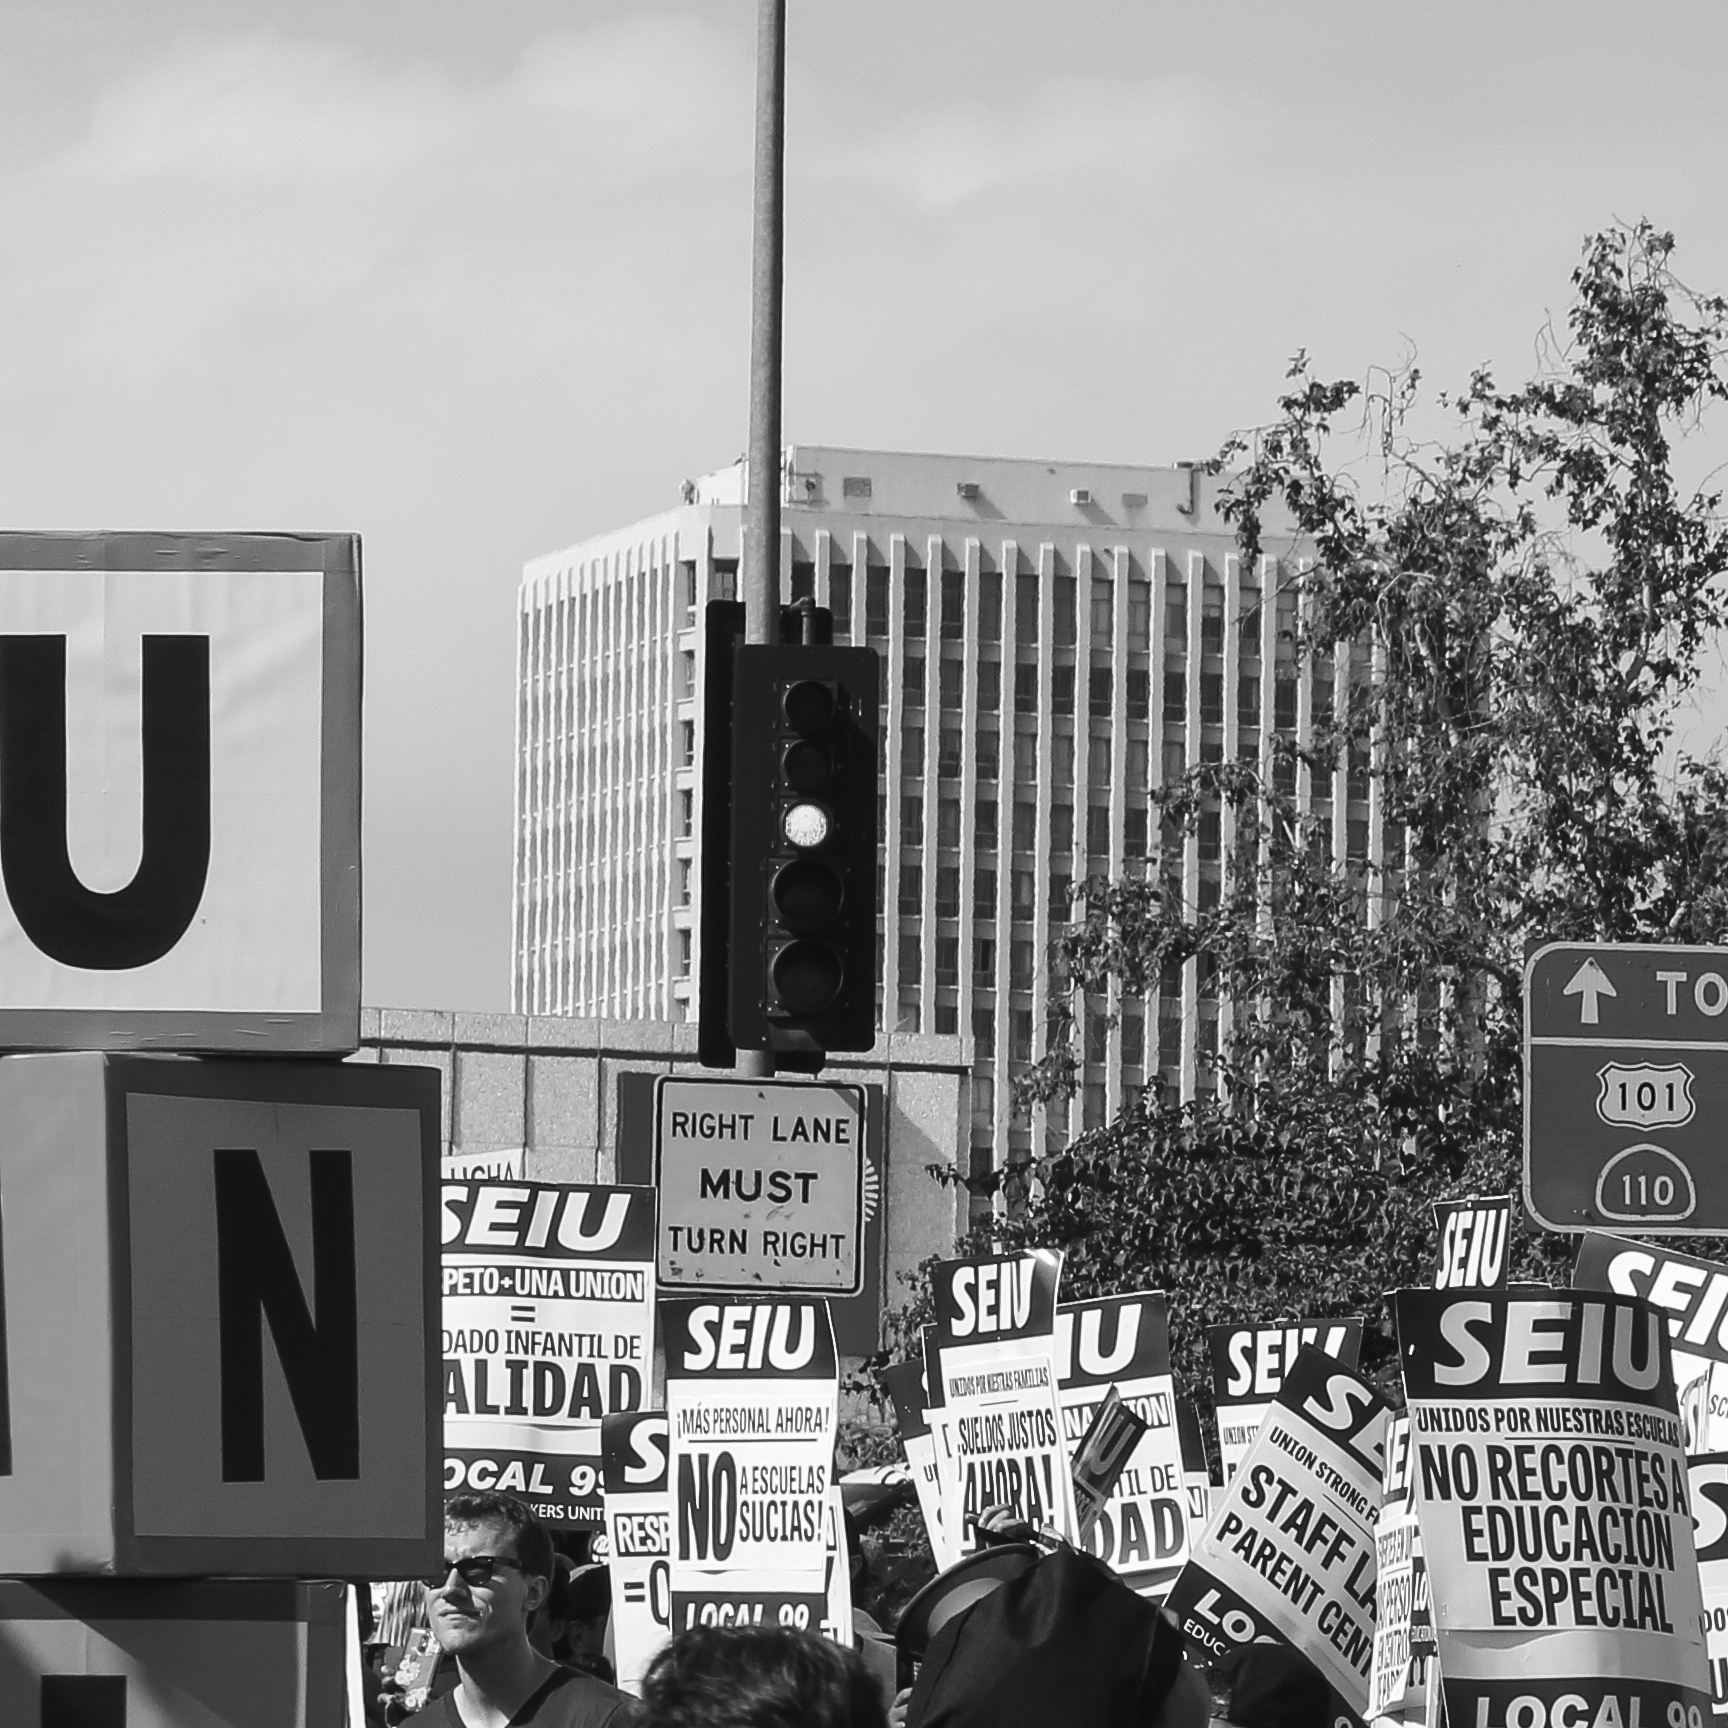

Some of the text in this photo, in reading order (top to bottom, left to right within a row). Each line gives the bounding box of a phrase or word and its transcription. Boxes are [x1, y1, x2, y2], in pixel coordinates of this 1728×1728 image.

[1617, 1080, 1676, 1112] 101
[671, 1113, 851, 1145] RIGHT LANE
[700, 1169, 819, 1205] MUST
[1622, 1174, 1674, 1206] 110
[669, 1226, 846, 1260] TURN RIGHT
[213, 1148, 361, 1483] N
[683, 1303, 816, 1371] SEIU
[1434, 1301, 1659, 1390] SEIU
[1416, 1406, 1679, 1445] UNIDOS POR NUESTRAS ESCUELAS
[740, 1465, 825, 1495] A ESCUELAS
[1420, 1444, 1689, 1516] NO RECORTES A
[678, 1451, 737, 1561] NO
[739, 1500, 823, 1542] SUCIAS!
[1465, 1504, 1674, 1572] EDUCACION
[1491, 1567, 1673, 1634] ESPECIAL
